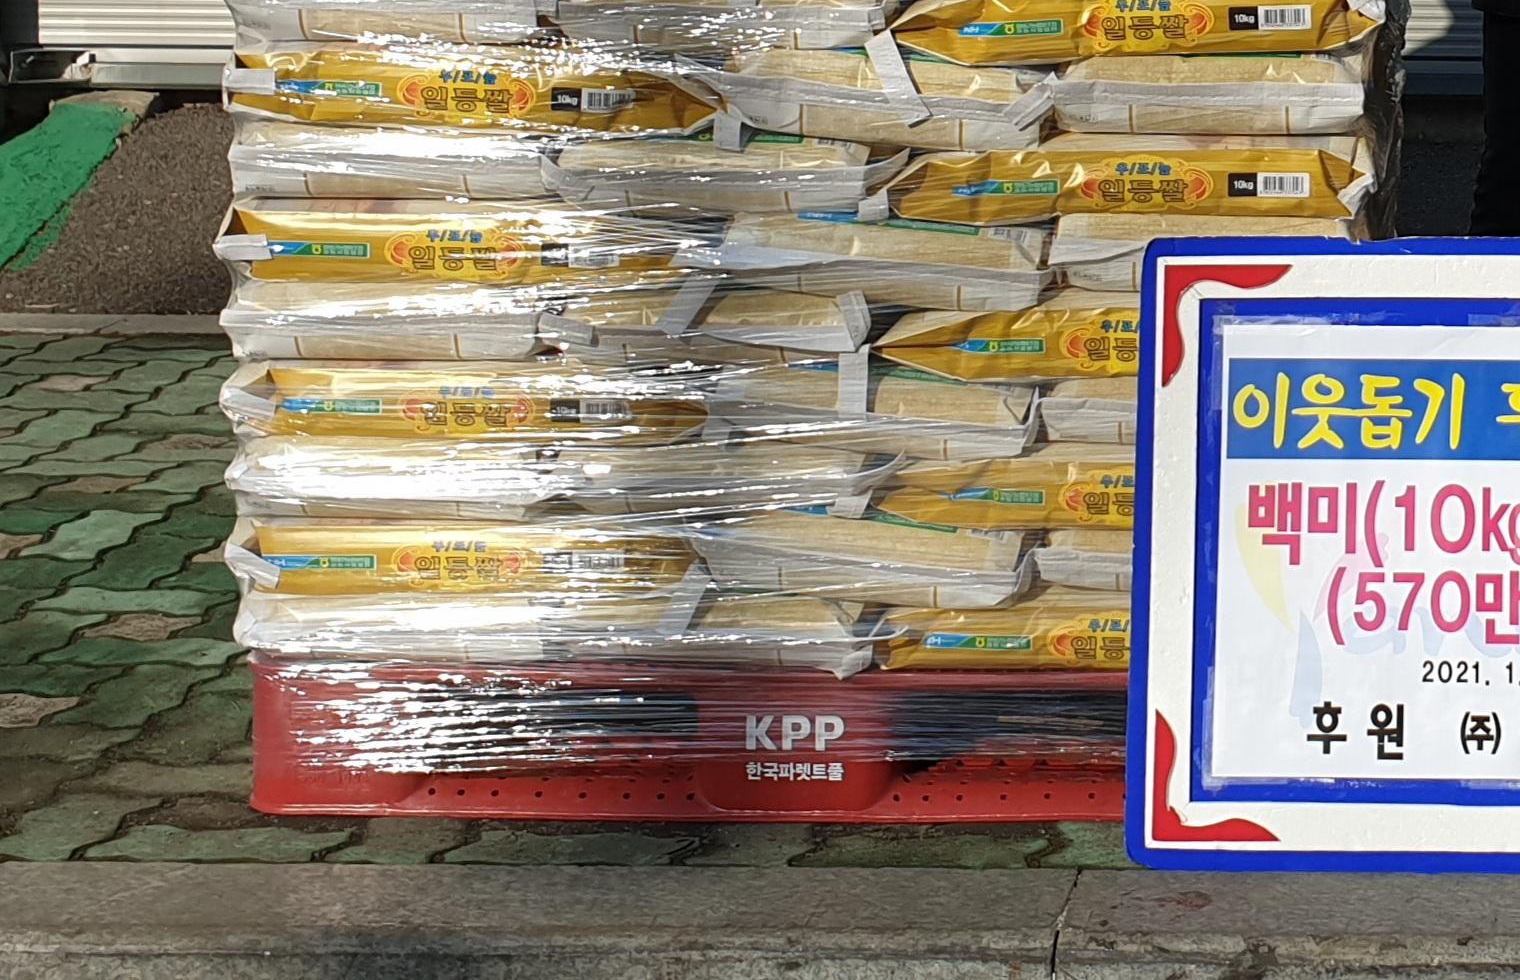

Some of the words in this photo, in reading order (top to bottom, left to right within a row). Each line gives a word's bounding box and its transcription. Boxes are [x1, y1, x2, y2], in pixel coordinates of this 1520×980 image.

[1101, 14, 1190, 41] 일등쌀
[1098, 178, 1189, 204] 일등쌀
[1084, 336, 1139, 362] 일등
[1232, 370, 1466, 452] 이웃돕기
[1083, 491, 1135, 517] 일등
[1070, 635, 1131, 661] 일등
[745, 714, 845, 751] KPP
[745, 762, 845, 781] 한국파렛트풀
